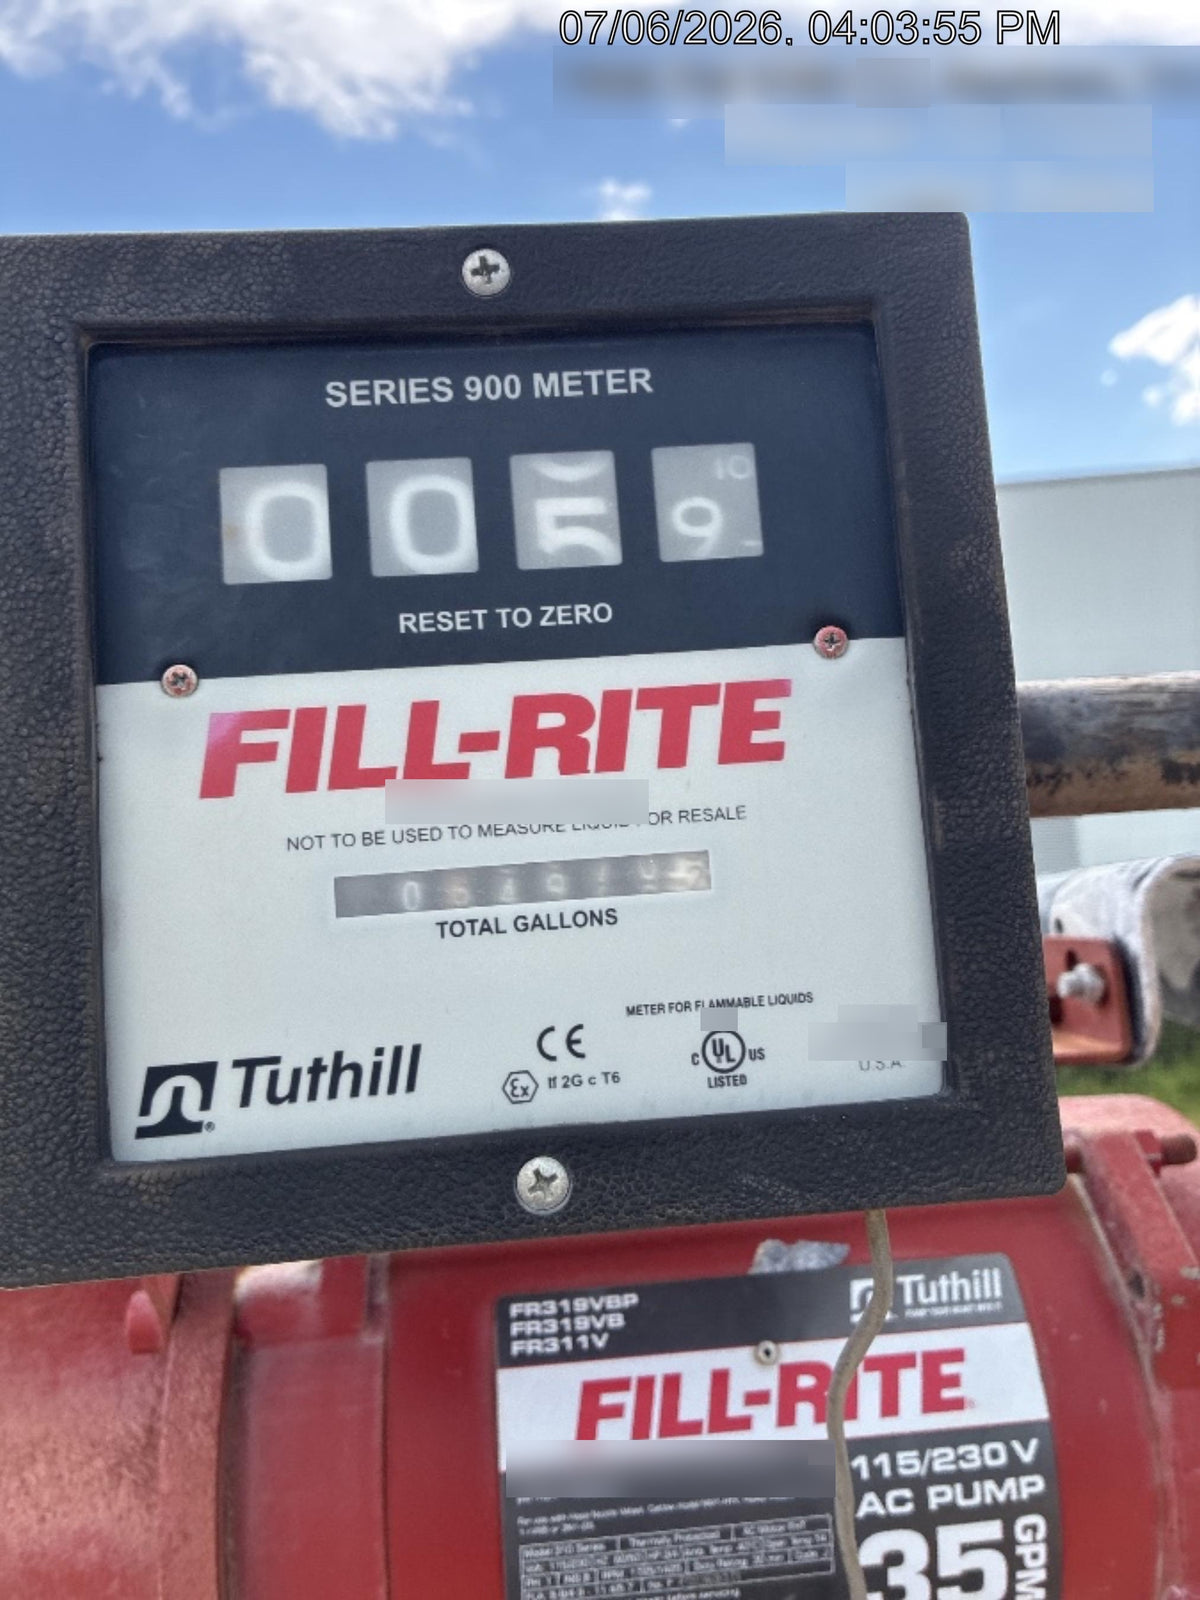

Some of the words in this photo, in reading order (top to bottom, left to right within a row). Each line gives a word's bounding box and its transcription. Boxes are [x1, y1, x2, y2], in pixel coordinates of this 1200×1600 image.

[325, 376, 454, 408] SERIES
[464, 374, 522, 402] 900
[533, 368, 654, 400] METER
[399, 609, 488, 634] RESET
[496, 607, 532, 631] TO
[540, 603, 614, 627] ZERO
[199, 679, 792, 799] FILL-RITE
[287, 835, 326, 851] NOT
[331, 833, 356, 848] TO
[362, 830, 386, 846] BE
[392, 826, 443, 844] USED
[448, 825, 472, 840] TO
[637, 810, 673, 826] OR
[678, 804, 747, 824] RESALE
[436, 916, 507, 940] TOTAL
[513, 908, 619, 933] GALLONS
[626, 1004, 666, 1017] METER
[668, 1002, 692, 1014] FOR
[767, 992, 814, 1007] LIQUIDS
[748, 1047, 766, 1061] US
[232, 1043, 422, 1108] Tuthill
[561, 1074, 583, 1089] 2G
[601, 1071, 621, 1085] T6
[707, 1073, 748, 1089] LISTED
[896, 1267, 1004, 1306] Tuthill
[509, 1293, 640, 1319] FR319VBP
[509, 1312, 626, 1337] FR319VB
[510, 1331, 610, 1357] FR311V
[855, 1487, 916, 1519] AC
[926, 1473, 1047, 1512] PUMP
[858, 1518, 1009, 1600] 35
[1013, 1512, 1048, 1600] GPM
